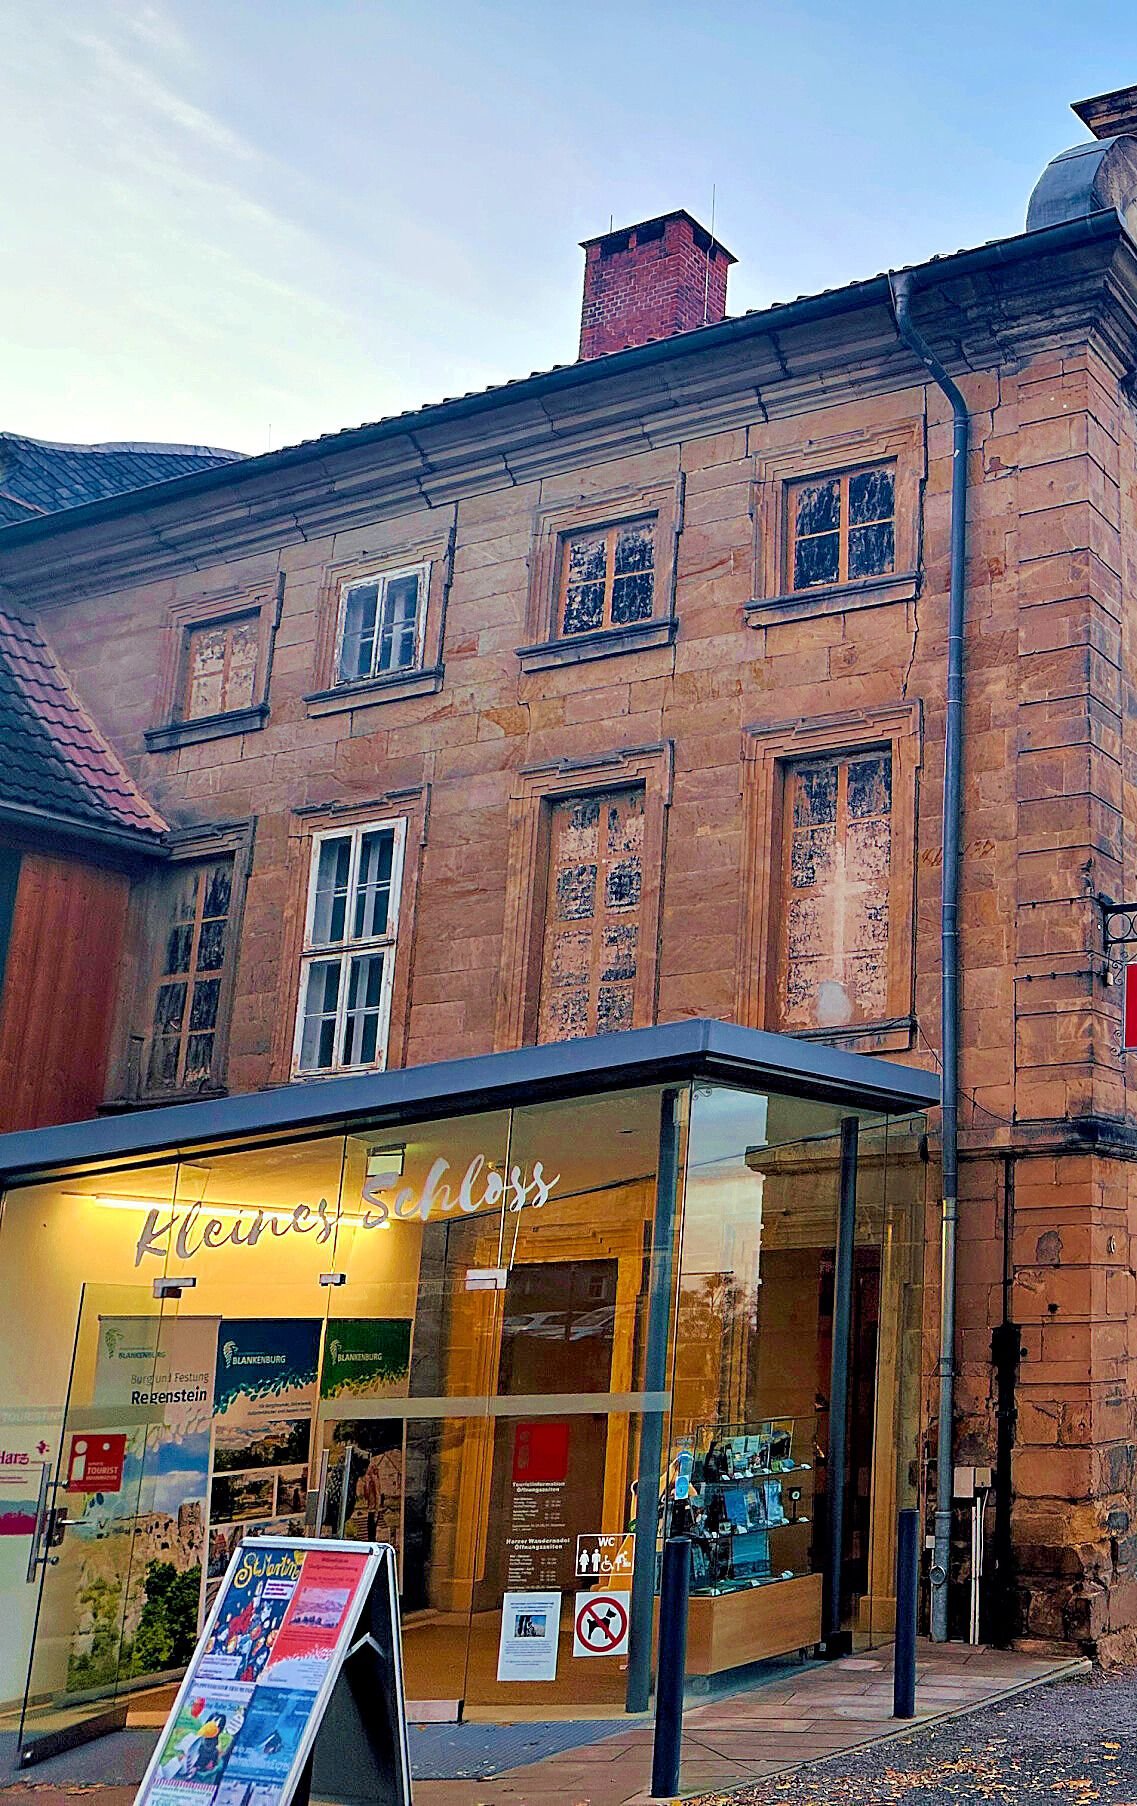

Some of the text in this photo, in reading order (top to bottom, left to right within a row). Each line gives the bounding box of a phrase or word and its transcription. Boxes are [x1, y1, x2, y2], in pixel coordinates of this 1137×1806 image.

[134, 1153, 560, 1267] Kleines Schloss
[118, 1351, 167, 1359] BLANKENBURG
[232, 1355, 286, 1365] BLANKENBURG
[337, 1352, 383, 1362] BLANKENBURG
[131, 1372, 209, 1385] Burg und Festung
[131, 1385, 207, 1405] Regenstein
[87, 1466, 119, 1474] TOURIST
[598, 1537, 616, 1547] WC
